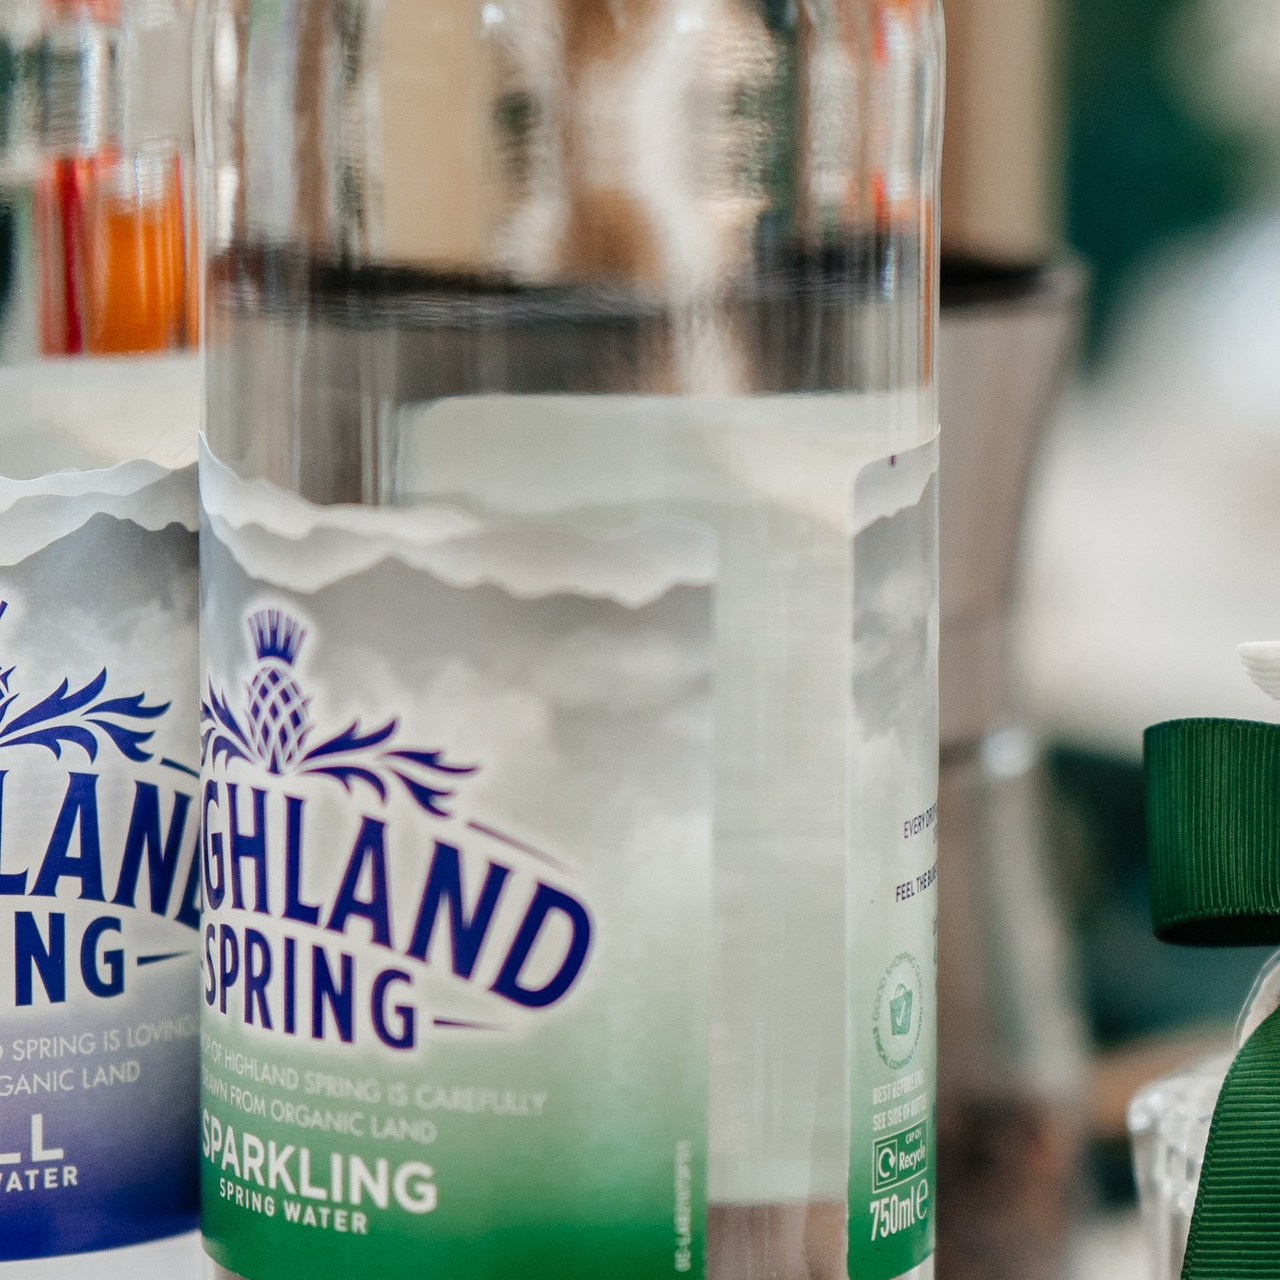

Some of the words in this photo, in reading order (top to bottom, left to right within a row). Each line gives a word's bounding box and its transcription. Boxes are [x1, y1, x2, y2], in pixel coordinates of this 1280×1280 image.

[895, 880, 915, 903] FEEL
[916, 872, 928, 894] THE
[205, 922, 416, 1051] SPRING
[13, 1032, 96, 1062] SPRING
[104, 1028, 121, 1052] IS
[127, 1016, 198, 1048] LOVING
[83, 1060, 141, 1090] LAND
[224, 1048, 299, 1092] HIGHLAND
[303, 1072, 382, 1105] SPRING
[387, 1081, 409, 1108] IS
[872, 1084, 891, 1106] BEST
[230, 1085, 267, 1118] FROM
[270, 1099, 367, 1138] ORGANIC
[369, 1114, 438, 1145] LAND
[872, 1111, 887, 1132] SEE
[887, 1106, 903, 1127] SIDE
[902, 1102, 911, 1121] OF
[202, 1108, 438, 1214] SPARKLING
[898, 1139, 926, 1172] Recycle
[219, 1177, 275, 1219] SPRING
[282, 1199, 369, 1236] WATER
[870, 1185, 916, 1242] 750ml
